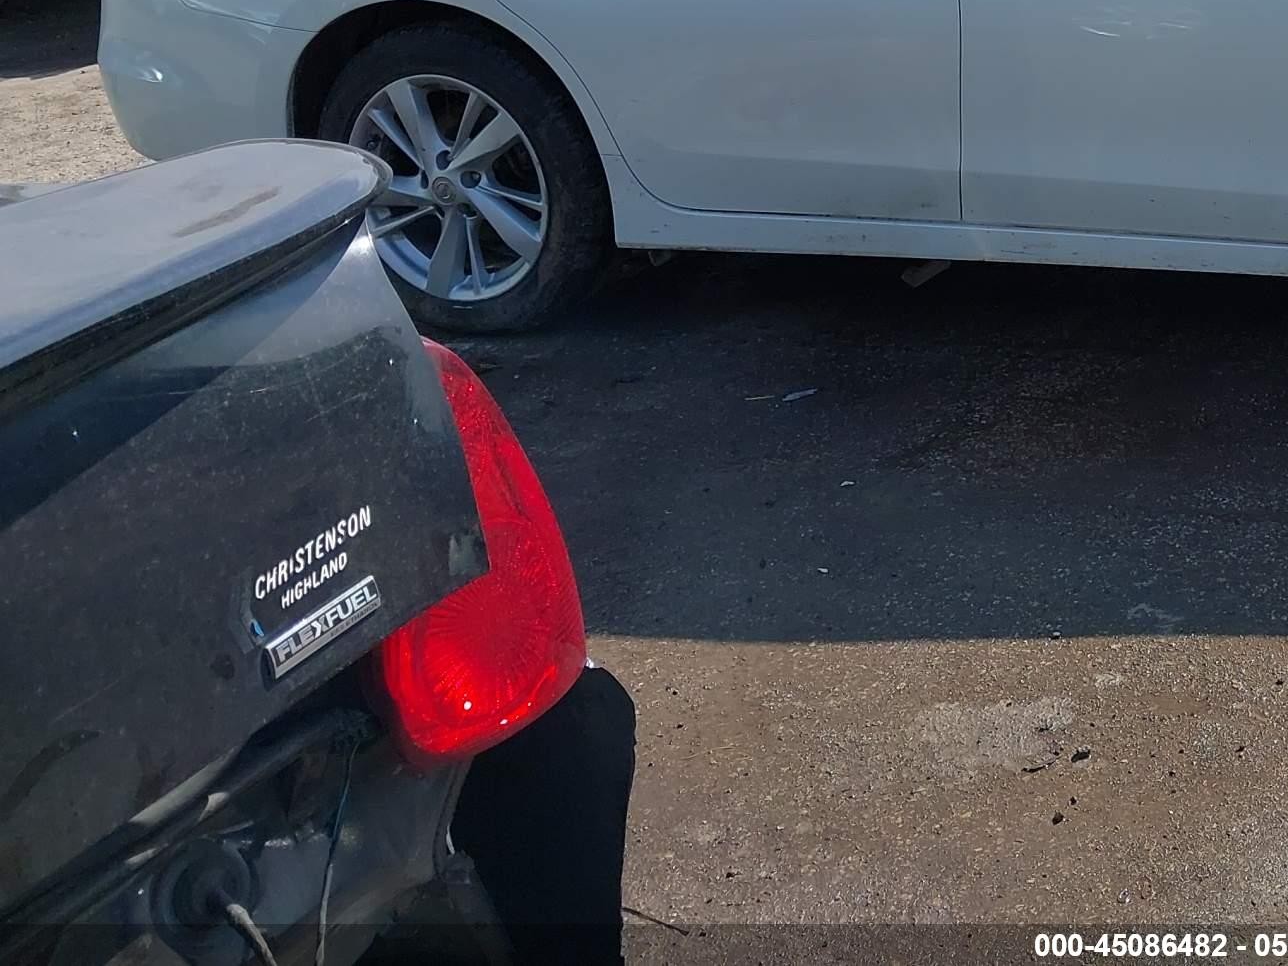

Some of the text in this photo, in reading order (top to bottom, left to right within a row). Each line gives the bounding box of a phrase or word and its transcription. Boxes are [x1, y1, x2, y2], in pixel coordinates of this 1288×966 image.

[255, 505, 372, 600] CHRISTENSON
[281, 552, 348, 610] HIGHLAND
[275, 584, 377, 663] FLEXFUEL
